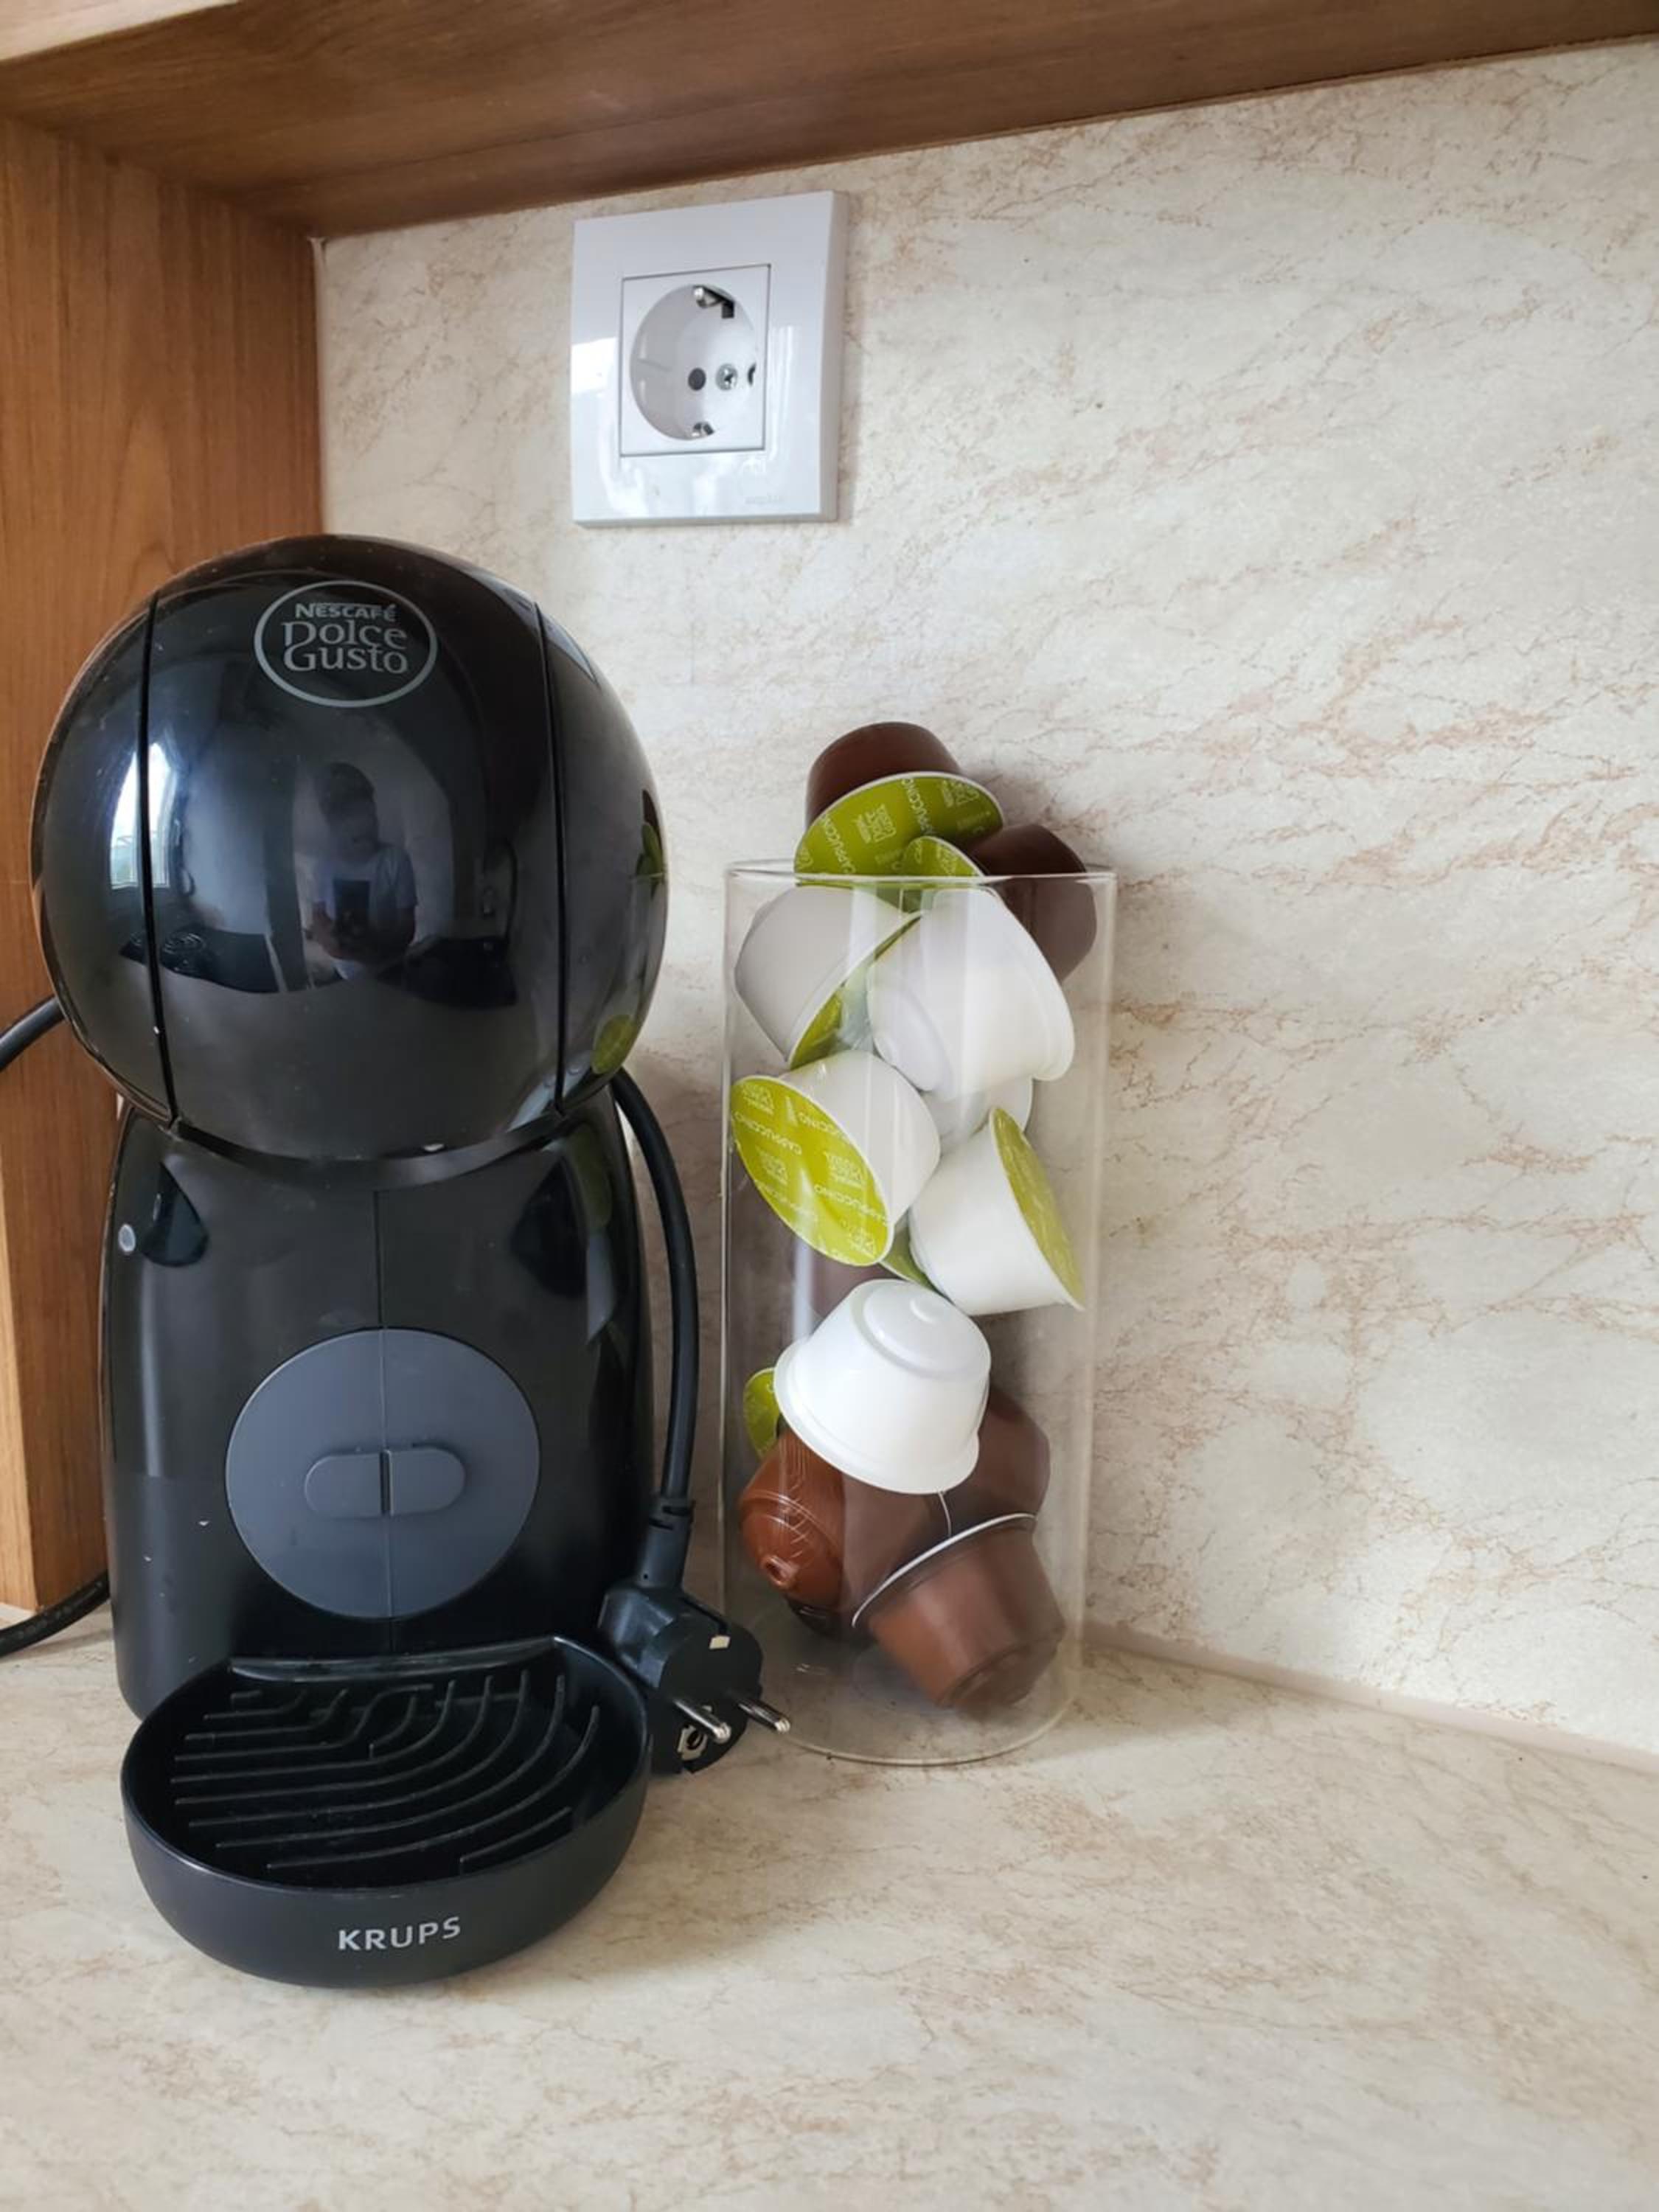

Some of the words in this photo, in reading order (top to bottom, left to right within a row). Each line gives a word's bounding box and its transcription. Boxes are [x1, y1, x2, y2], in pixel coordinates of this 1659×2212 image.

[295, 602, 398, 622] NESCAFÉ
[281, 619, 408, 650] Dolce
[283, 644, 408, 674] Gusto
[338, 1916, 461, 1950] KRUPS
